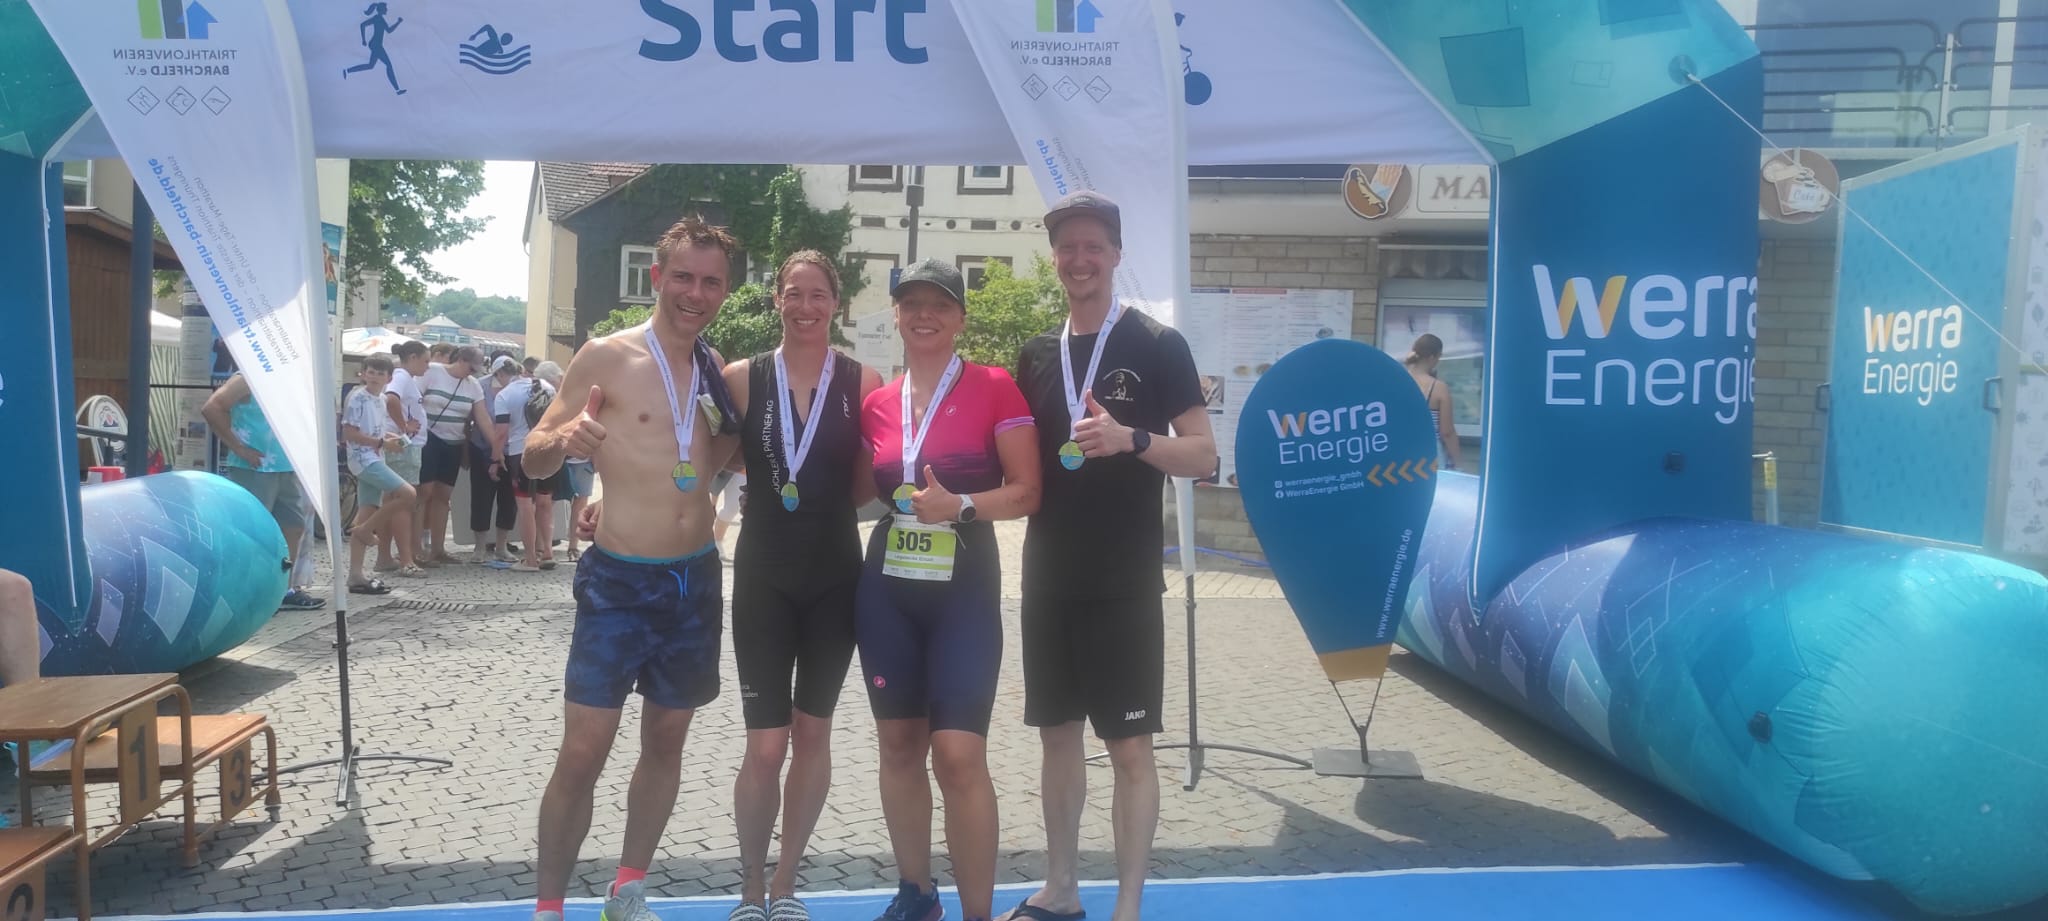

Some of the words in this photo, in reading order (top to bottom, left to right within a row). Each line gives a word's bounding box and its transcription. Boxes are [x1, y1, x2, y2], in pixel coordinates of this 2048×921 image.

[638, 0, 929, 64] Start
[1532, 264, 1758, 340] Werr
[766, 399, 774, 413] AG
[1545, 345, 1756, 424] Energi
[1863, 352, 1958, 406] Energie
[762, 413, 774, 452] PARTNER
[1279, 430, 1389, 465] Energie
[1124, 709, 1146, 721] JAKO
[129, 723, 147, 803] 1
[229, 749, 246, 808] 3
